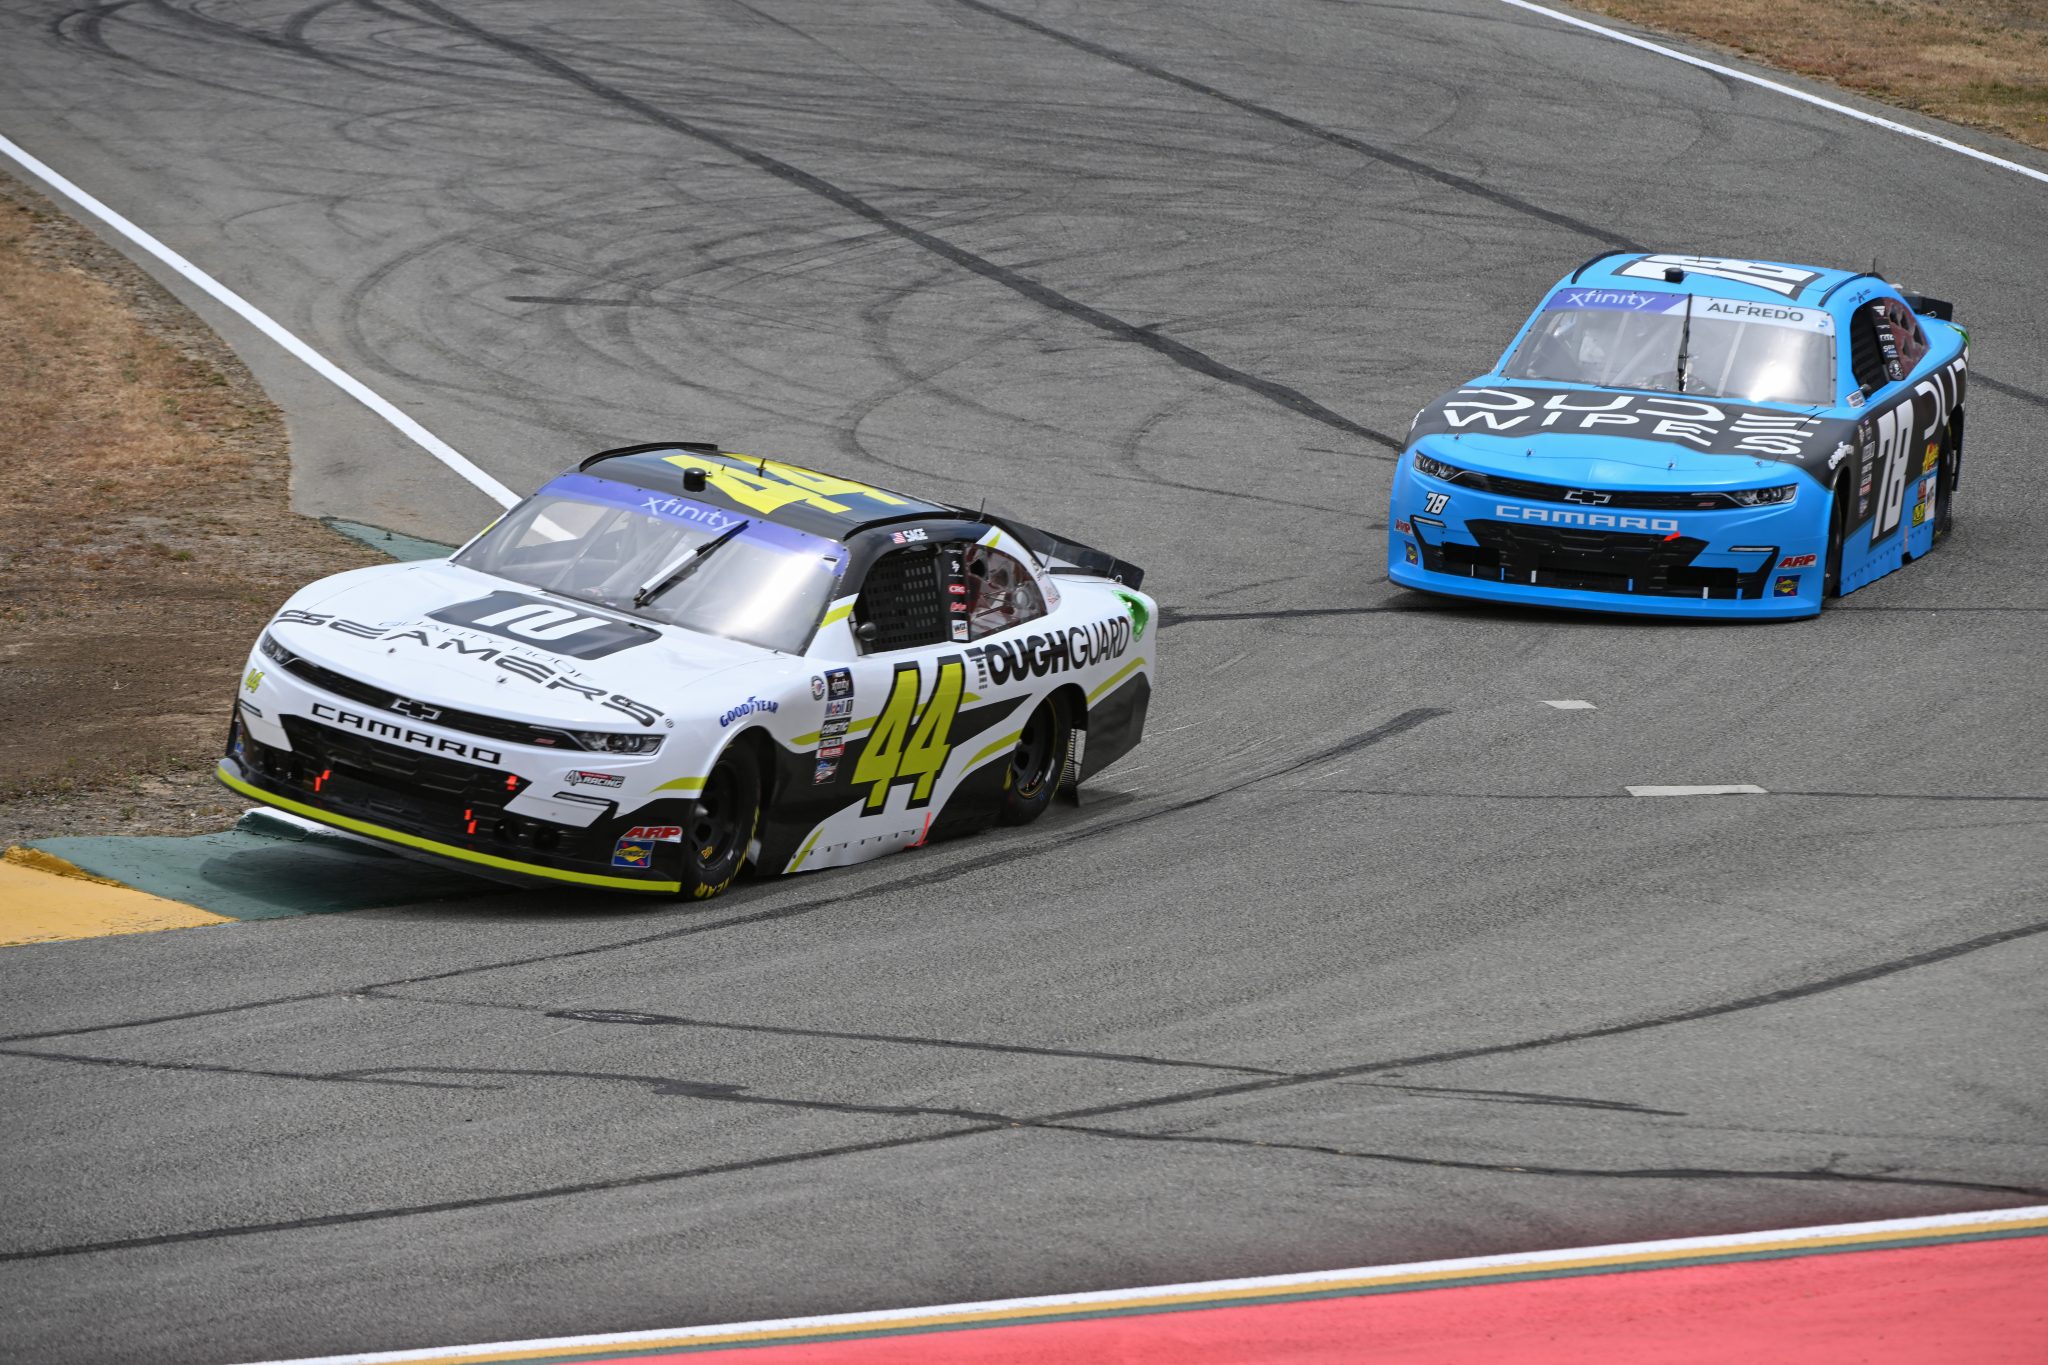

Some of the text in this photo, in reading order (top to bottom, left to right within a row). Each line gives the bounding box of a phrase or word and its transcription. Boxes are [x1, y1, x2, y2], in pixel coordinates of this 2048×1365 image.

[1566, 290, 1656, 310] xfinity
[1707, 303, 1804, 322] ALFREDO
[1445, 390, 1822, 438] DUDE
[1442, 409, 1802, 458] WIPES
[662, 453, 909, 515] 44
[1872, 398, 1914, 542] 78
[640, 496, 741, 532] xfinity
[1424, 492, 1450, 515] 78
[1496, 505, 1678, 531] CAMARO
[903, 528, 928, 542] SAGE
[1779, 555, 1817, 568] ARP
[245, 668, 264, 693] 44
[273, 609, 665, 727] SEAMERS
[720, 696, 778, 727] GOODYEAR
[311, 703, 502, 765] CAMARO
[851, 653, 965, 818] 44
[583, 776, 622, 788] RACING
[624, 827, 681, 839] ARP
